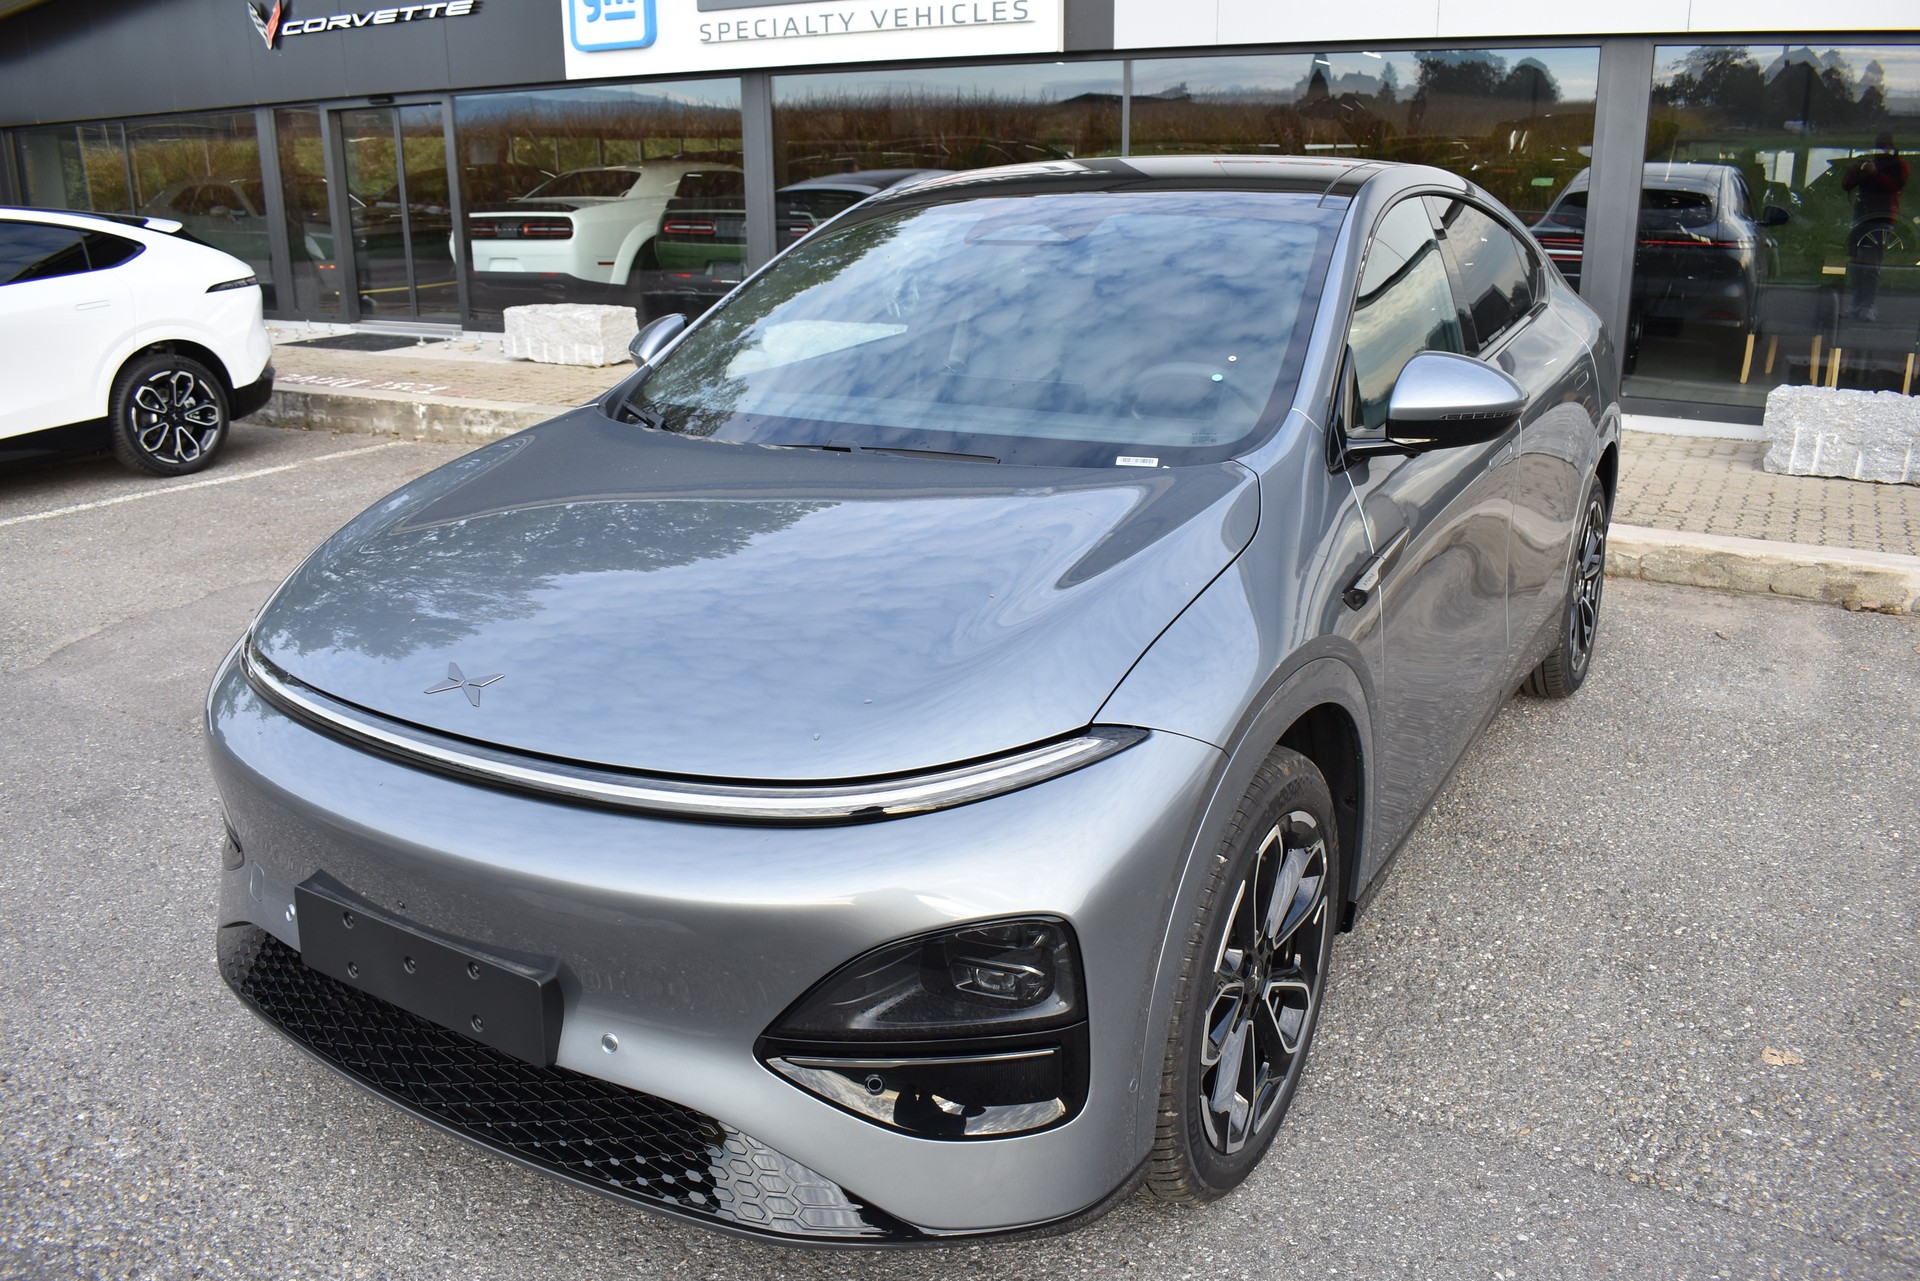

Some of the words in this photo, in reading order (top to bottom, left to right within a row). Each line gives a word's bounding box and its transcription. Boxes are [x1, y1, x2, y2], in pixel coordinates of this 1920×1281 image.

[281, 0, 475, 36] CORVETTE
[700, 11, 856, 42] SPECIALTY
[870, 0, 1029, 29] VEHICLES
